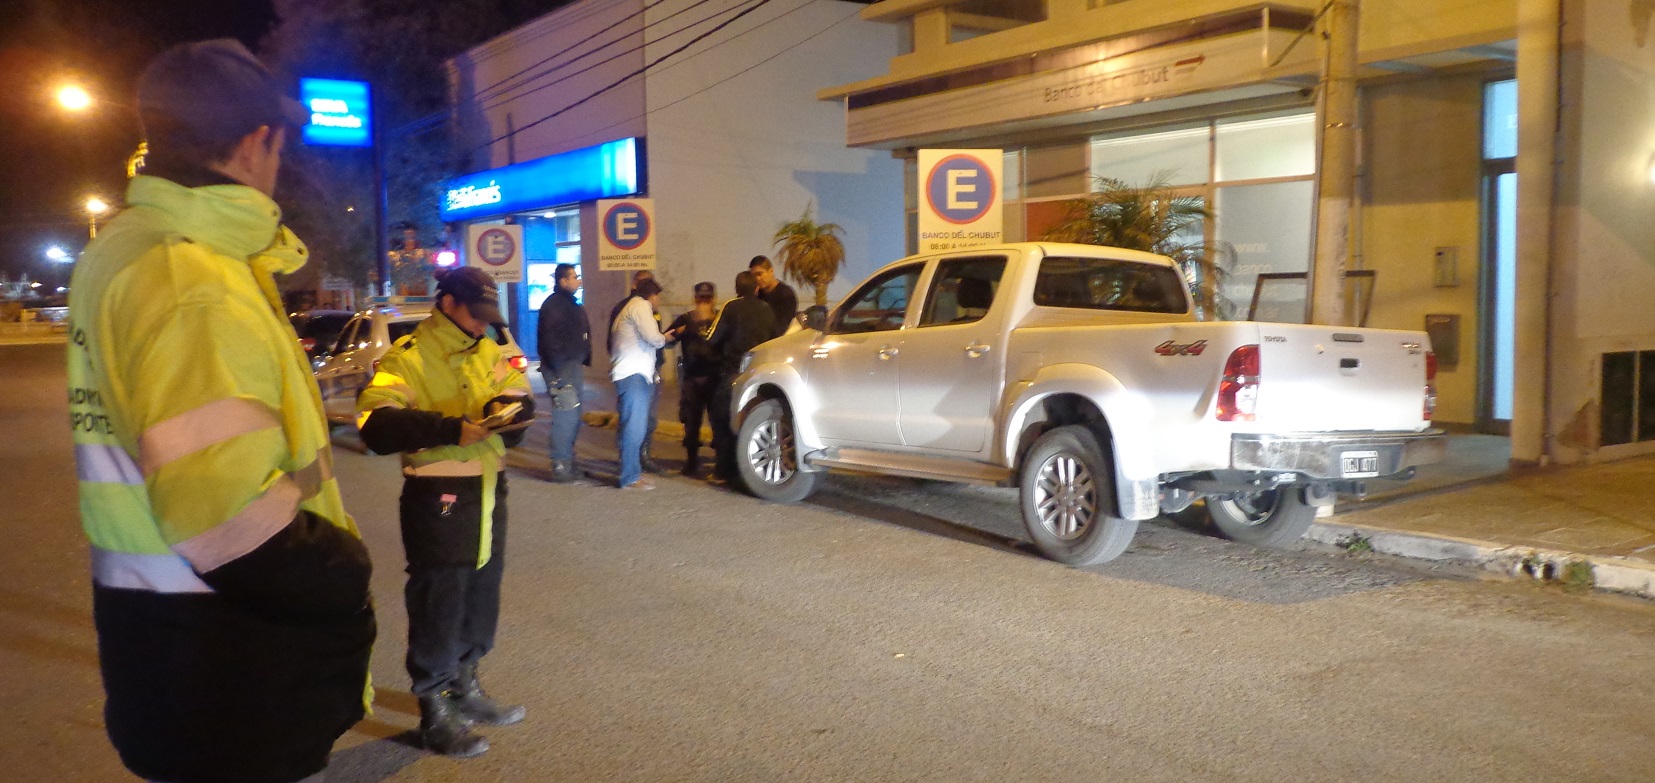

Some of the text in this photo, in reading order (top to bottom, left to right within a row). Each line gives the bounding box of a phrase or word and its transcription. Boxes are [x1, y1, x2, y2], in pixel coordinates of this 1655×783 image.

[946, 169, 978, 209] E
[616, 212, 639, 240] E
[922, 231, 950, 239] BANCO
[968, 231, 1001, 239] CHUBUT
[487, 236, 507, 258] E
[1155, 339, 1209, 356] 4x4
